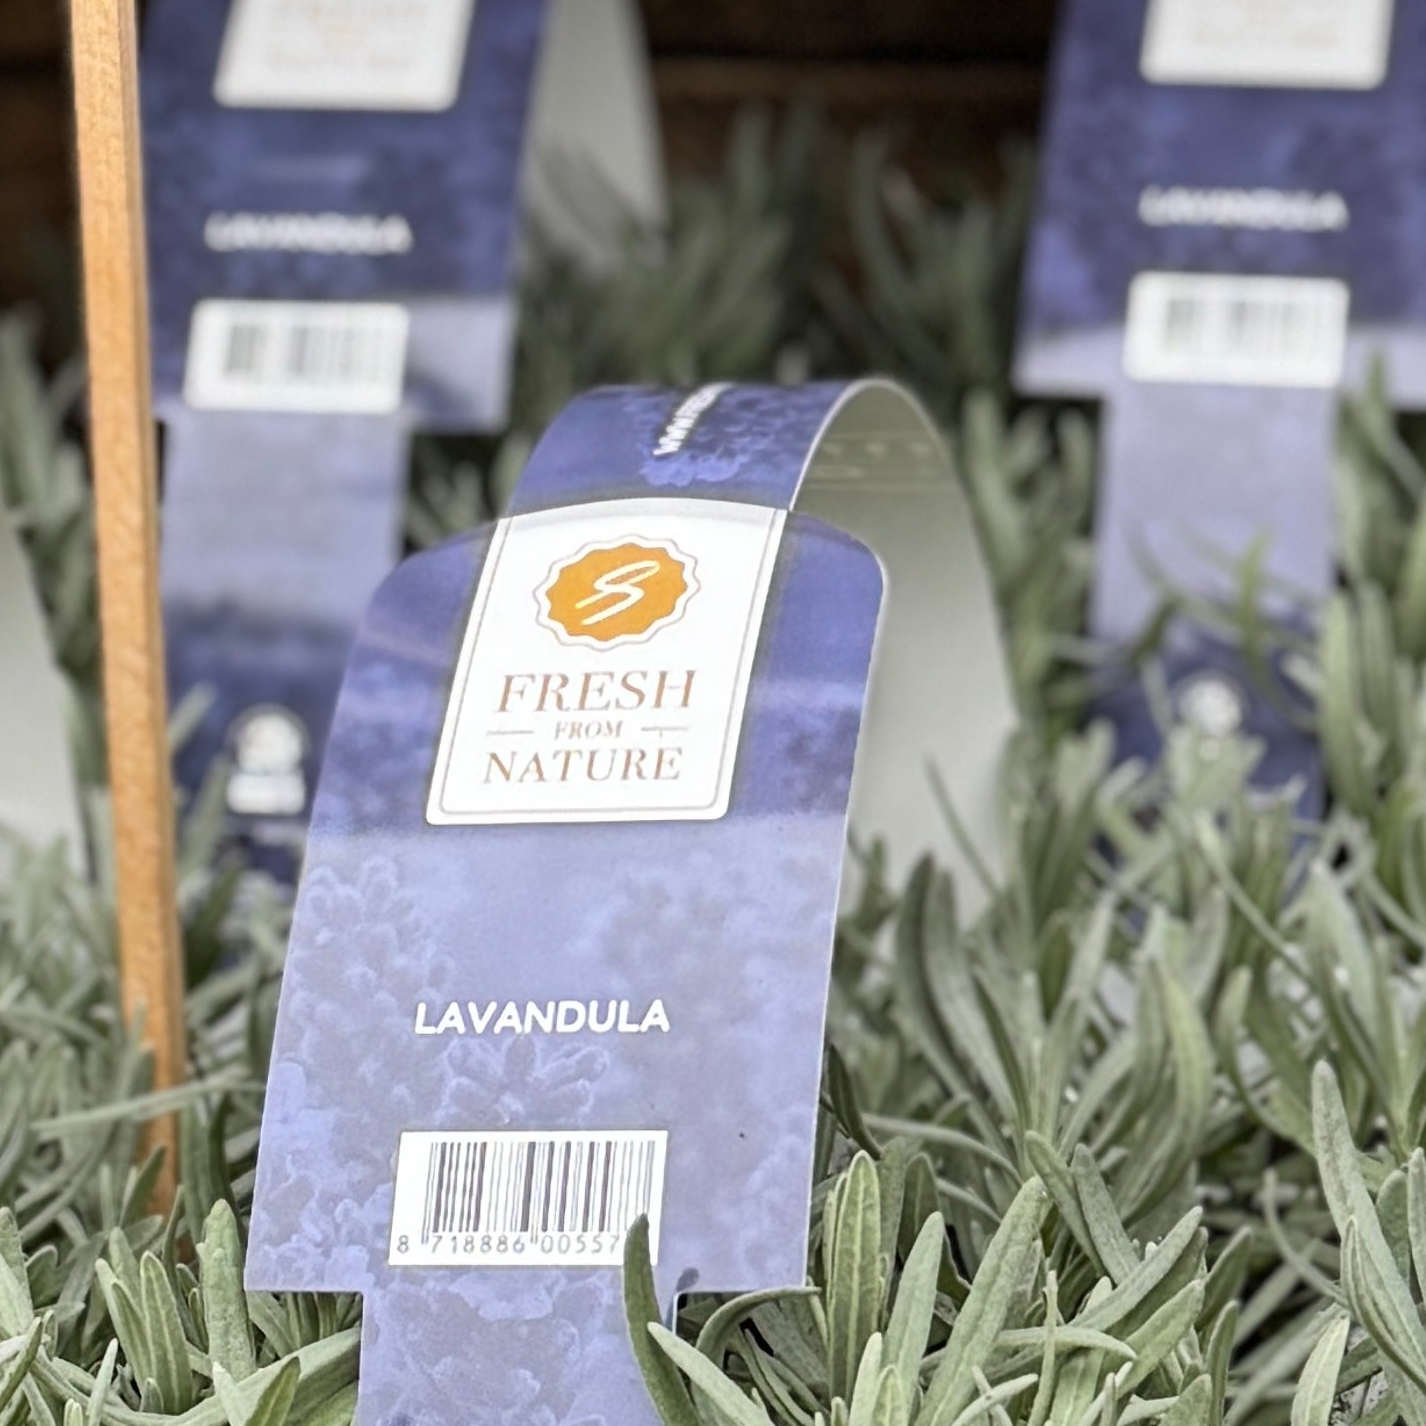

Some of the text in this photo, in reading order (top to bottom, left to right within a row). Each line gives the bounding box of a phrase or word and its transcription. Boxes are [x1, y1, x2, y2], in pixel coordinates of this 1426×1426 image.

[494, 669, 697, 714] FRESH
[553, 720, 624, 741] FROM
[482, 746, 684, 785] NATURE
[414, 999, 670, 1035] LAVANDULA
[540, 1234, 620, 1254] 00557
